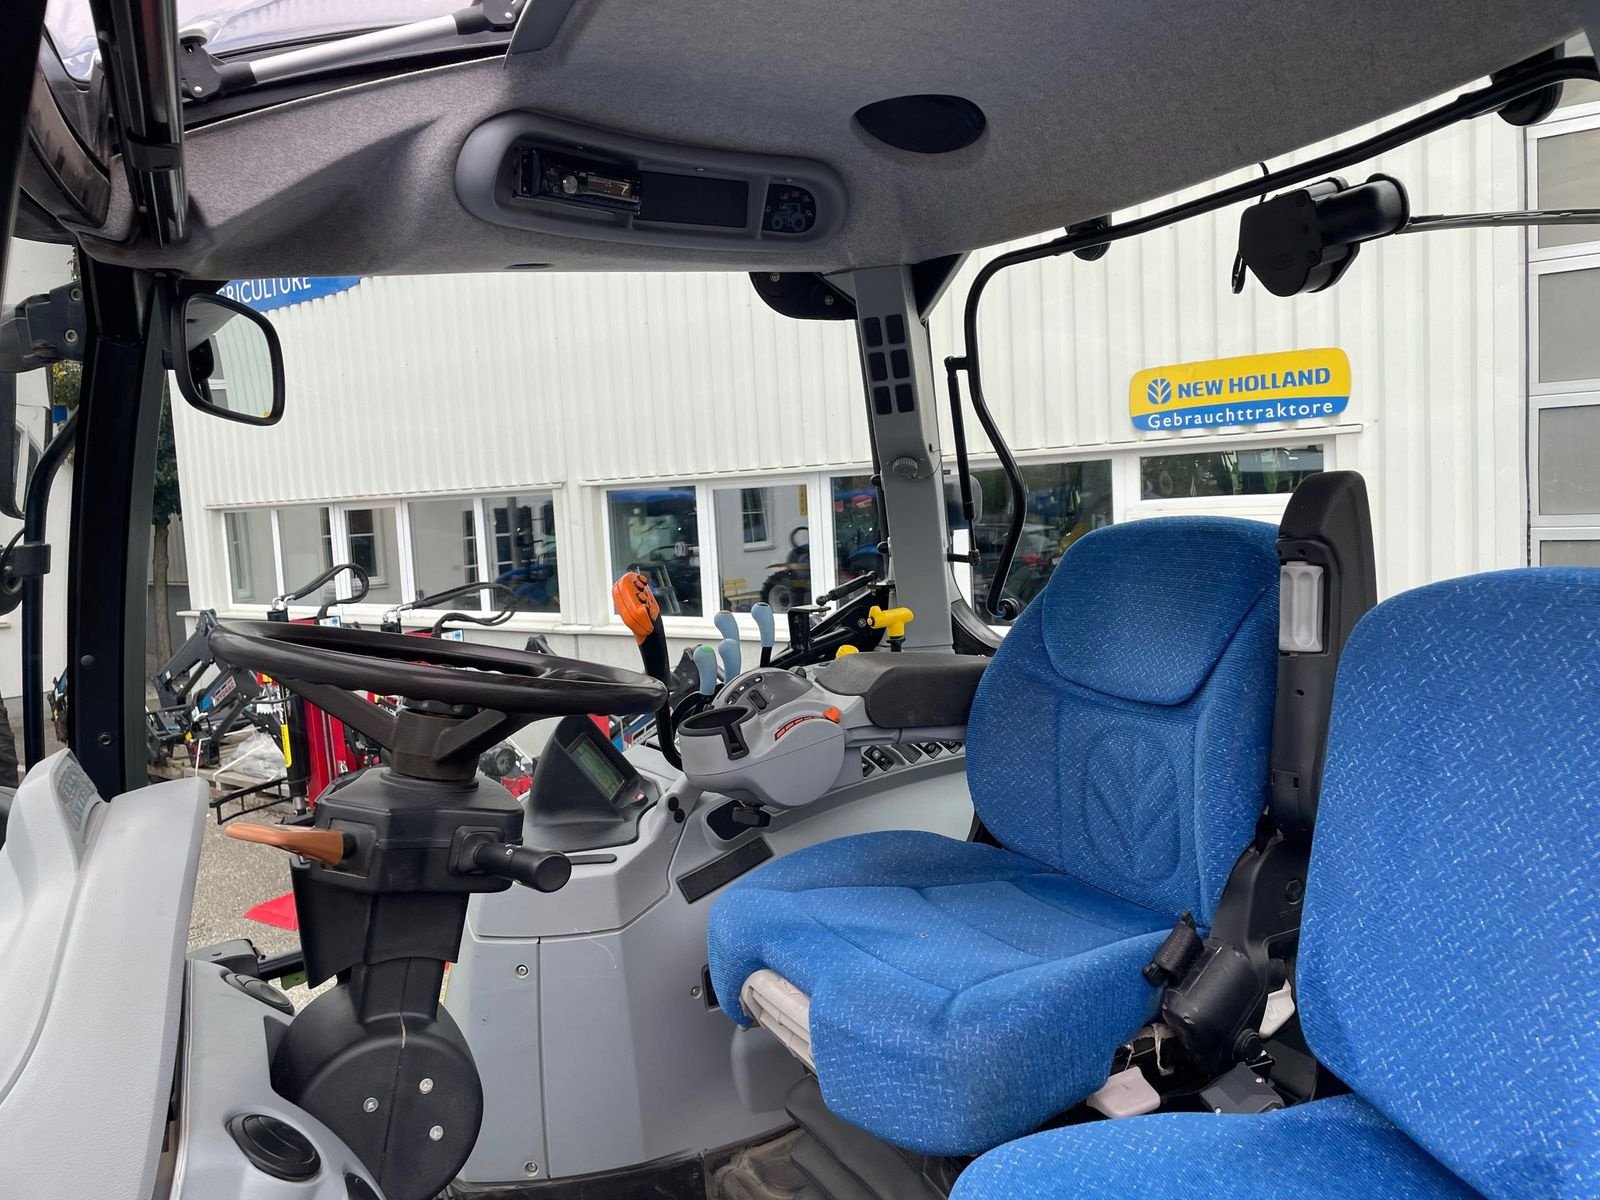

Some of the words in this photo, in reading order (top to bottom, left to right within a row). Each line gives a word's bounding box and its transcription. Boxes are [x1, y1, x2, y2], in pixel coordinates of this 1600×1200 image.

[1178, 379, 1223, 399] NEW
[1229, 367, 1331, 394] HOLLAND
[1148, 402, 1333, 429] Gebrauchttraktore
